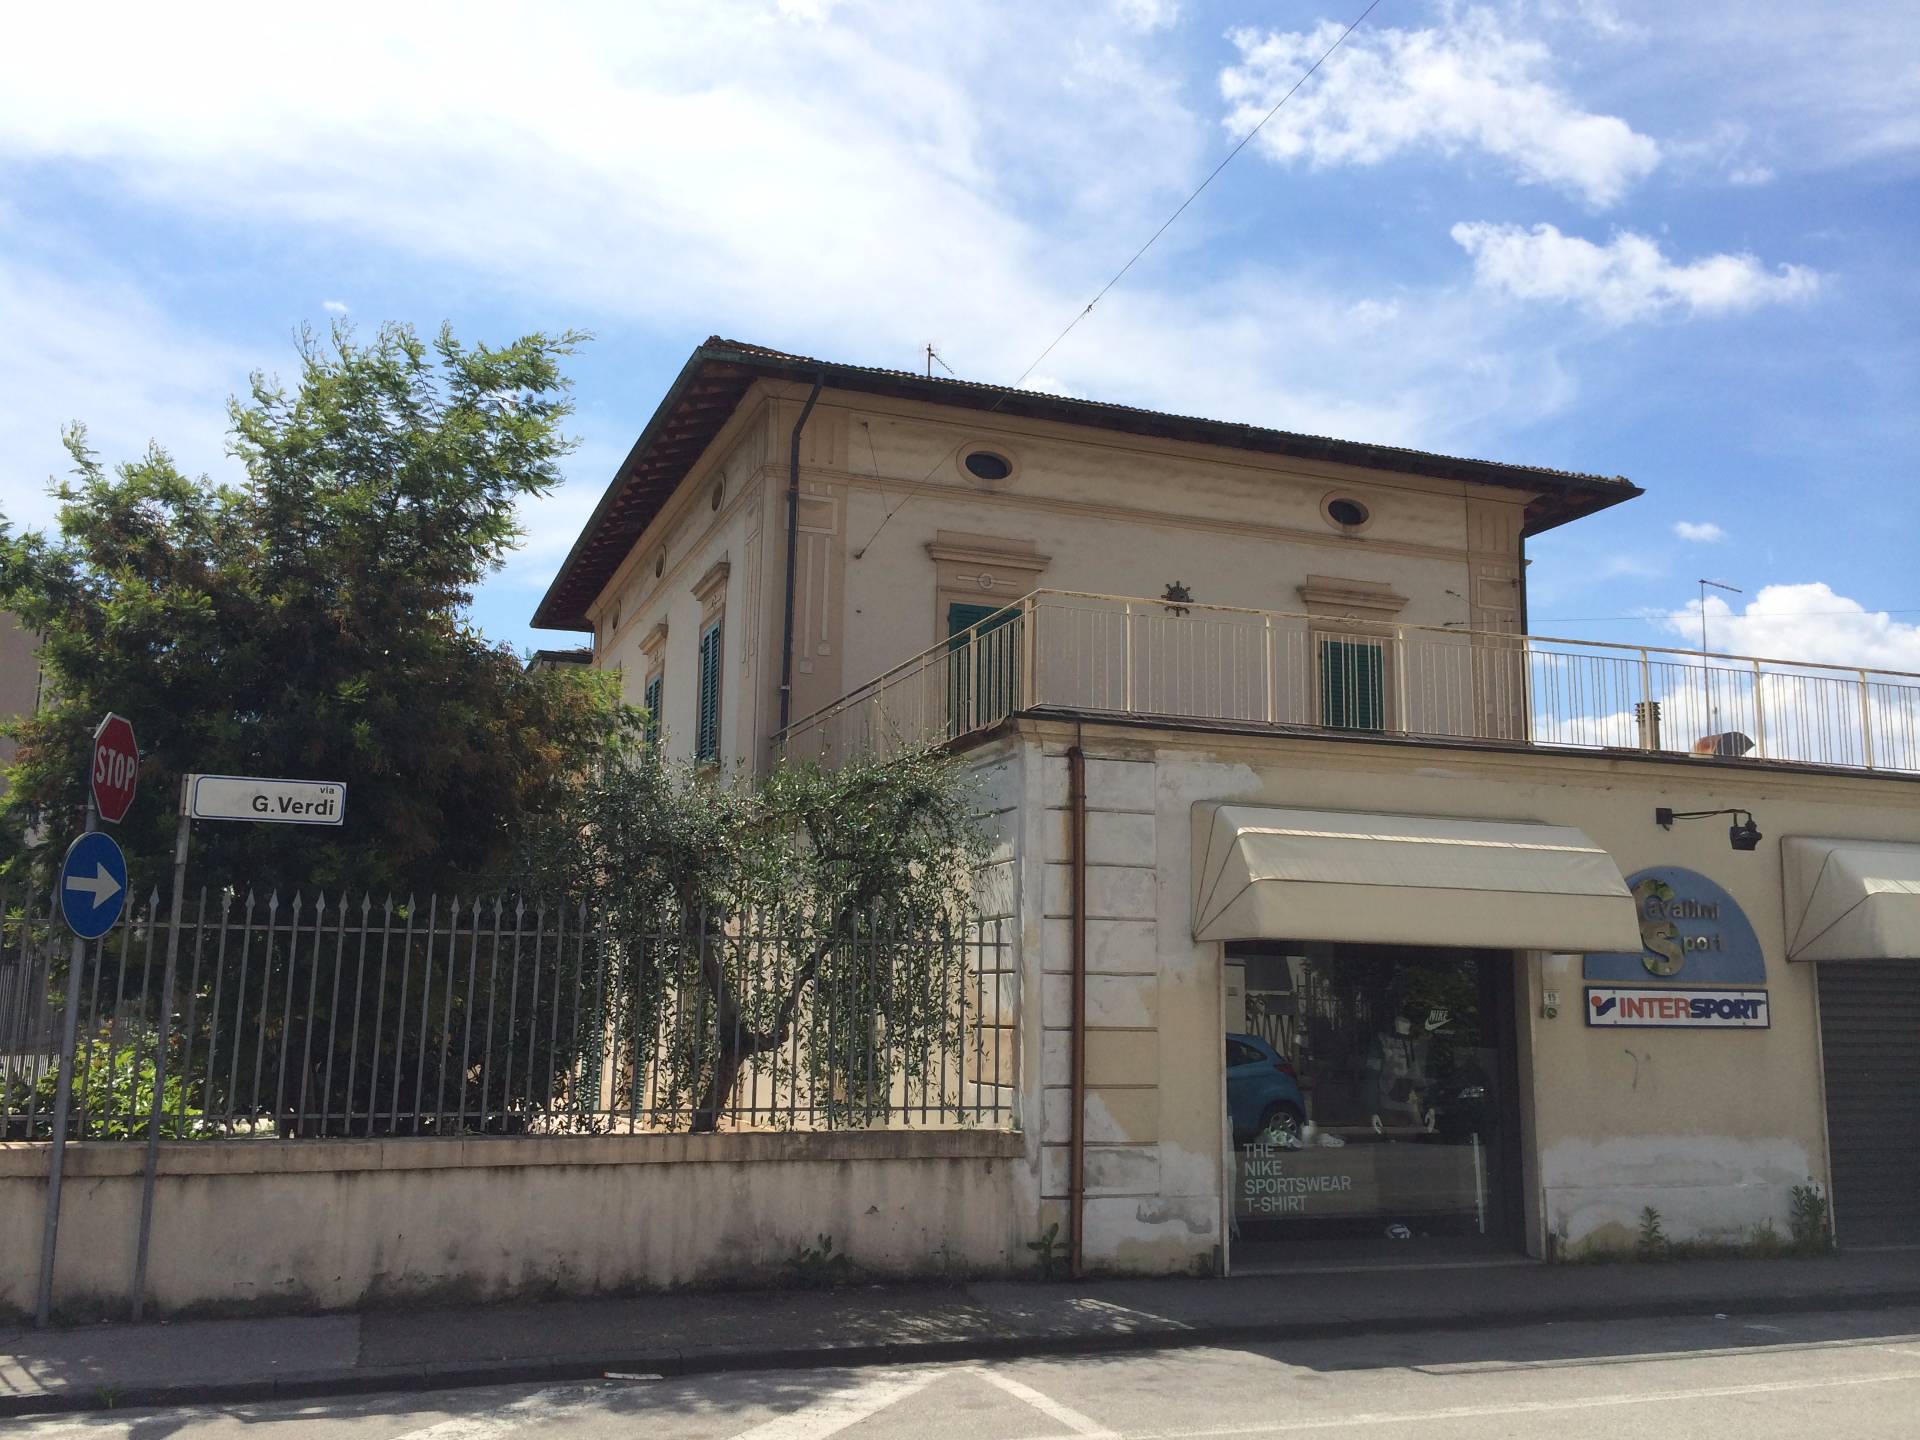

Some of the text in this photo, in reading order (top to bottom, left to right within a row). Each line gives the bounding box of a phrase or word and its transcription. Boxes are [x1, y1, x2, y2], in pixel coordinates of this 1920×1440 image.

[96, 745, 136, 792] STOP
[320, 786, 335, 795] via
[252, 795, 335, 816] G.Verdi
[1429, 1009, 1449, 1022] NIKE
[1619, 996, 1765, 1020] INTERSPORT
[1243, 1143, 1276, 1158] THE
[1244, 1160, 1283, 1177] NIKE
[1244, 1175, 1352, 1195] SPORTSWEAR
[1244, 1195, 1308, 1213] T-SHIRT
